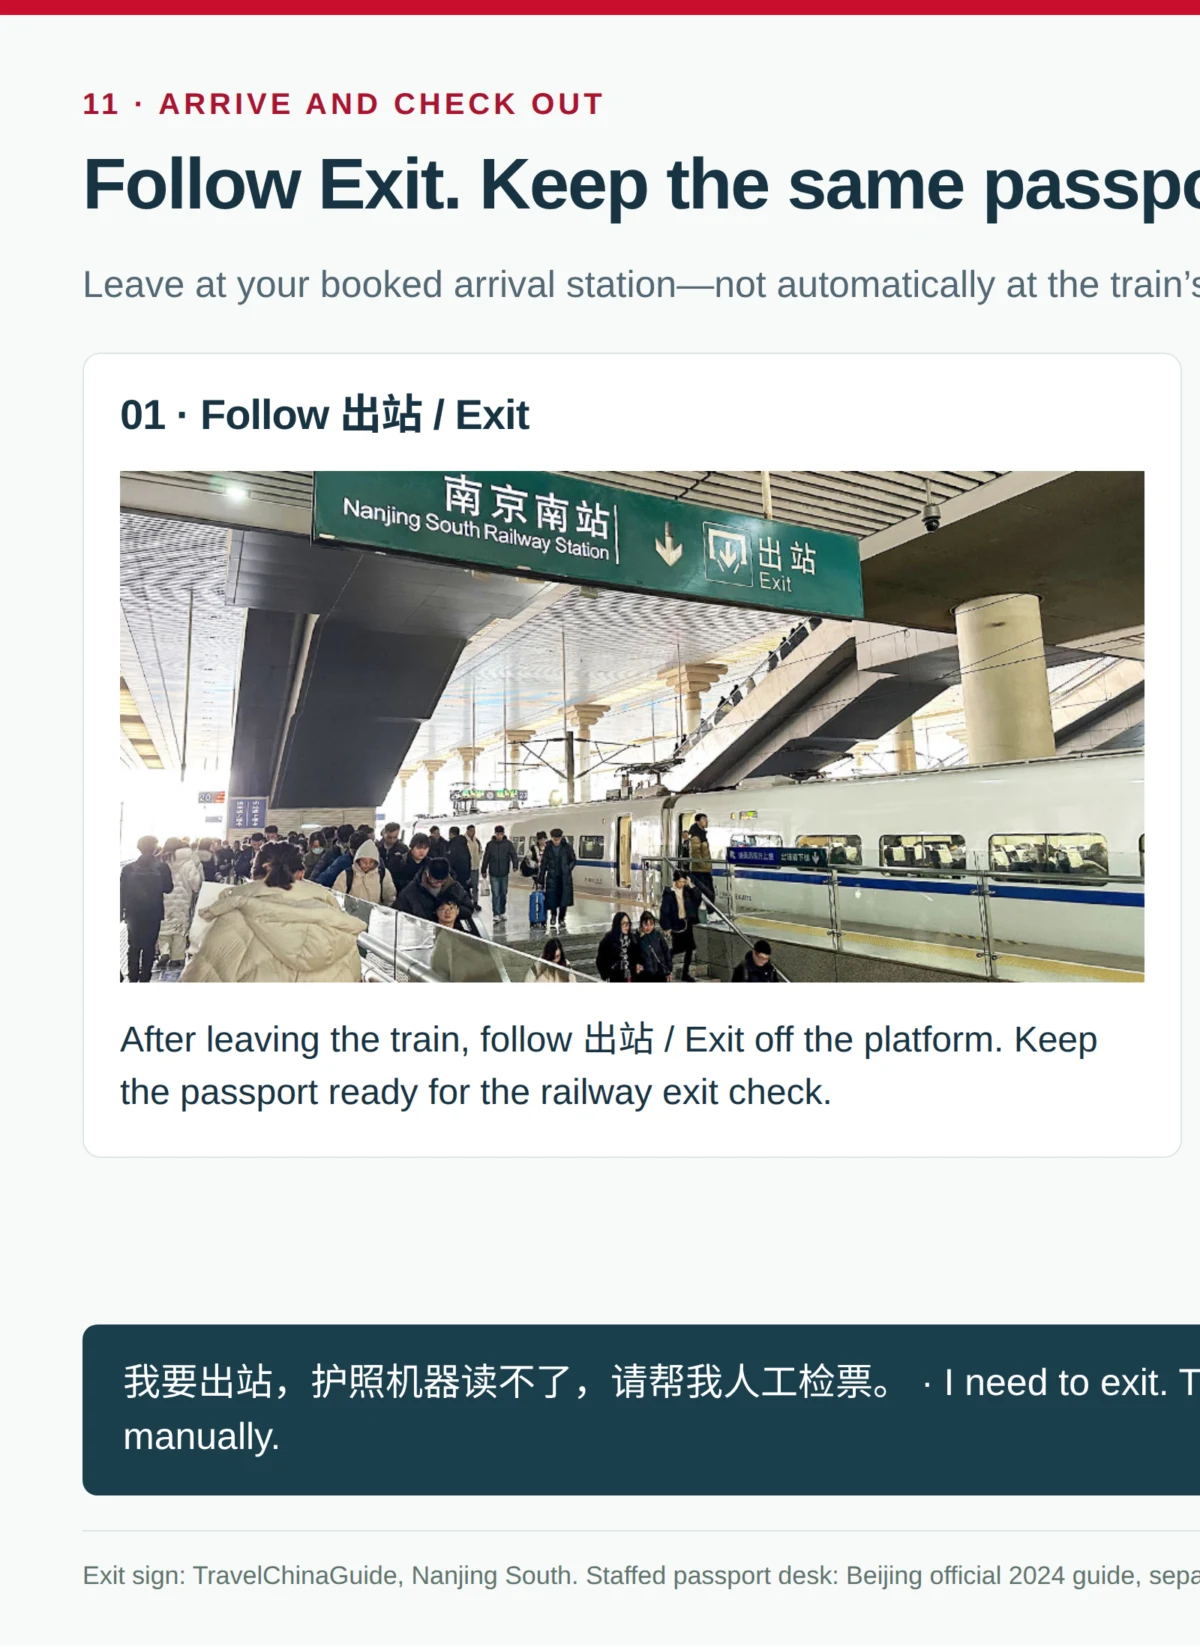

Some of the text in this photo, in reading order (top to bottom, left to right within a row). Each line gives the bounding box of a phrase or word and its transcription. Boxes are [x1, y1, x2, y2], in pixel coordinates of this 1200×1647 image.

[84, 93, 118, 114] 11
[159, 93, 290, 114] ARRIVE
[306, 93, 377, 114] AND
[394, 93, 515, 115] CHECK
[532, 93, 602, 115] OUT
[87, 156, 302, 210] Follow
[322, 156, 458, 210] Exit.
[483, 159, 647, 224] Keep
[667, 156, 768, 210] the
[789, 169, 964, 210] same
[85, 271, 183, 298] Leave
[196, 272, 227, 298] at
[237, 276, 309, 305] your
[322, 269, 441, 298] booked
[455, 270, 554, 298] arrival
[567, 269, 766, 298] station—not
[778, 269, 995, 305] automatically
[1007, 272, 1037, 298] at
[1048, 269, 1098, 298] the
[121, 399, 165, 430] 01
[203, 398, 330, 430] Follow
[343, 393, 422, 433] 出站
[457, 398, 530, 430] Exit
[444, 473, 611, 540] 南京南站
[343, 497, 611, 561] Nanjing South Railway Station
[759, 536, 817, 576] 出站
[760, 571, 792, 593] Exit
[120, 1025, 196, 1053] After
[208, 1025, 318, 1059] leaving
[330, 1025, 379, 1052] the
[390, 1025, 468, 1057] train,
[480, 1025, 573, 1052] follow
[585, 1021, 654, 1055] 出站
[686, 1025, 744, 1052] Exit
[755, 1025, 794, 1052] off
[804, 1025, 853, 1052] the
[865, 1025, 1001, 1059] platform.
[1016, 1026, 1097, 1059] Keep
[120, 1077, 830, 1112] the passport ready for the railway exit check.
[124, 1363, 888, 1400] 我要出站，护照机器读不了，请帮我人工检票。
[947, 1369, 951, 1395] I
[967, 1367, 1046, 1396] need
[1059, 1370, 1089, 1396] to
[1101, 1367, 1166, 1396] exit.
[125, 1421, 278, 1457] manually.
[84, 1565, 125, 1584] Exit
[133, 1565, 184, 1590] sign:
[193, 1565, 402, 1587] TravelChinaGuide,
[413, 1565, 497, 1590] Nanjing
[506, 1565, 577, 1584] South.
[587, 1565, 665, 1585] Staffed
[674, 1567, 771, 1590] passport
[779, 1565, 837, 1585] desk:
[848, 1565, 921, 1590] Beijing
[930, 1565, 1000, 1585] official
[1009, 1566, 1065, 1584] 2024
[1073, 1565, 1140, 1590] guide,
